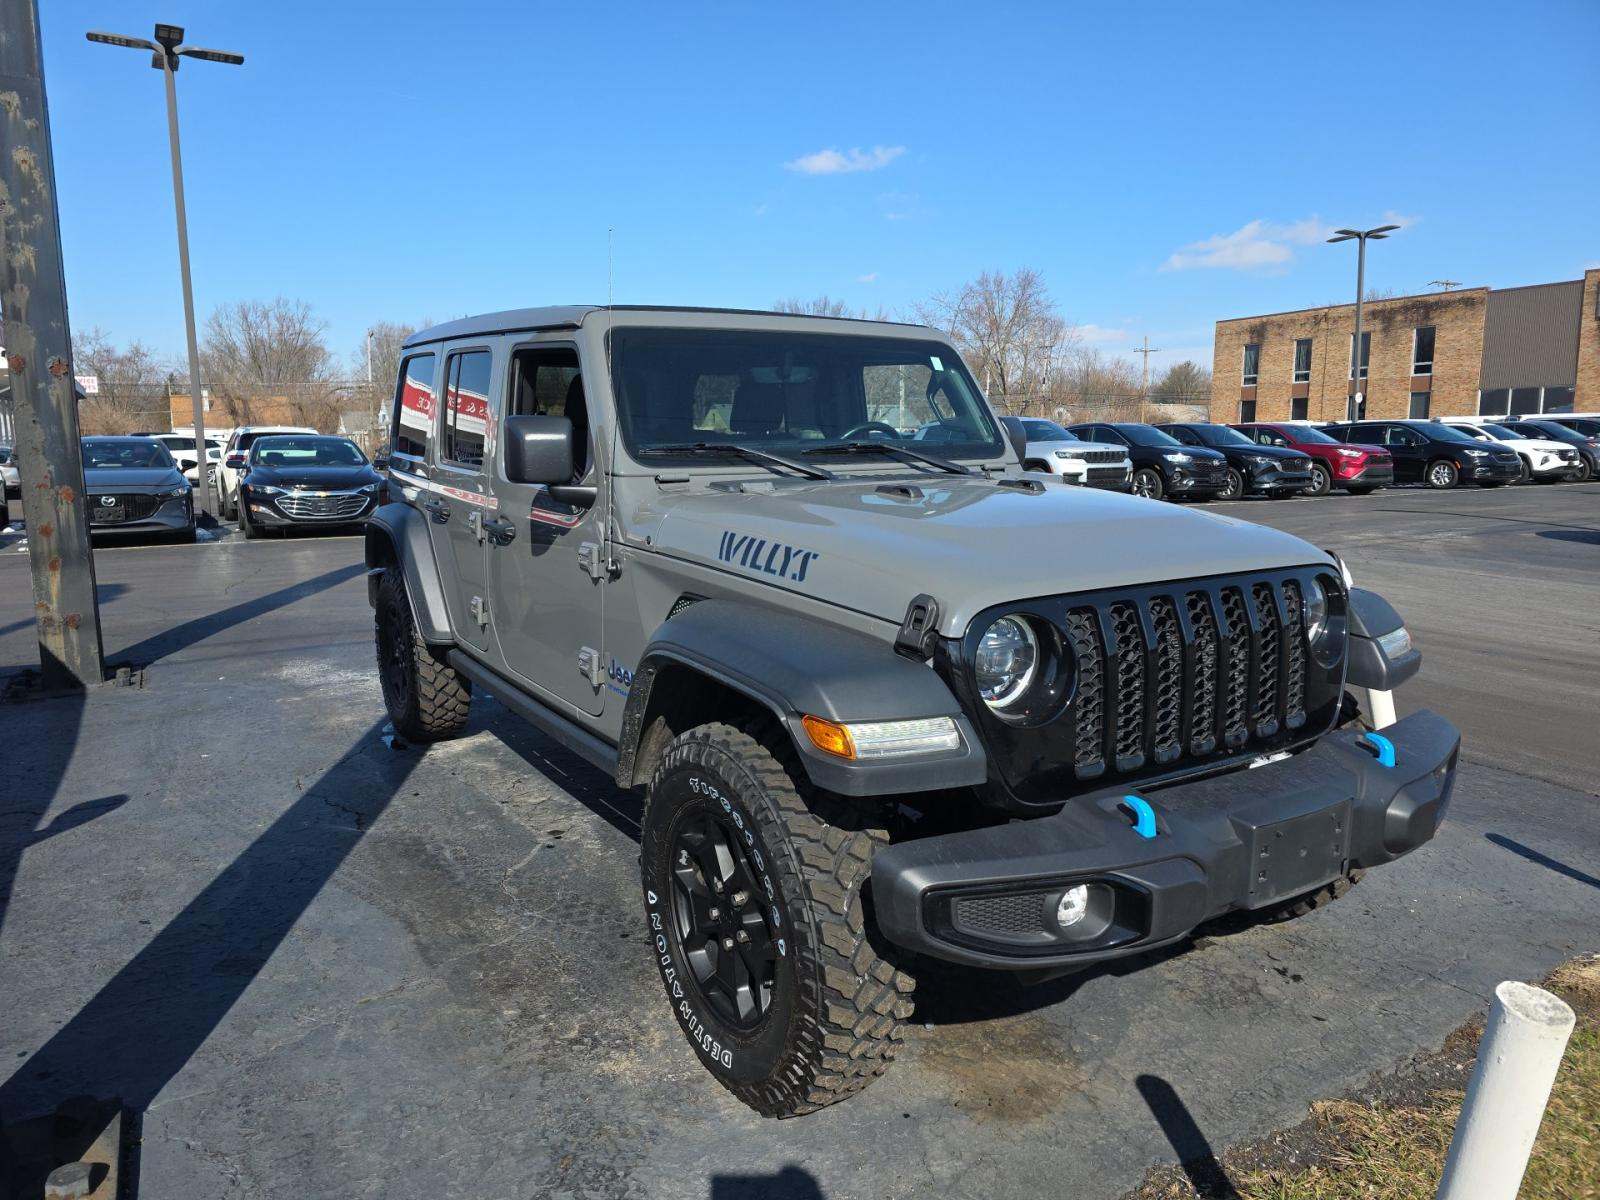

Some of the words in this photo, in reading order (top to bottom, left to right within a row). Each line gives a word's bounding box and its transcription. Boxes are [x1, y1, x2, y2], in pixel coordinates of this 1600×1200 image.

[718, 530, 819, 582] WILLYS
[608, 659, 634, 688] Jee
[650, 913, 733, 1069] DESTINATION
